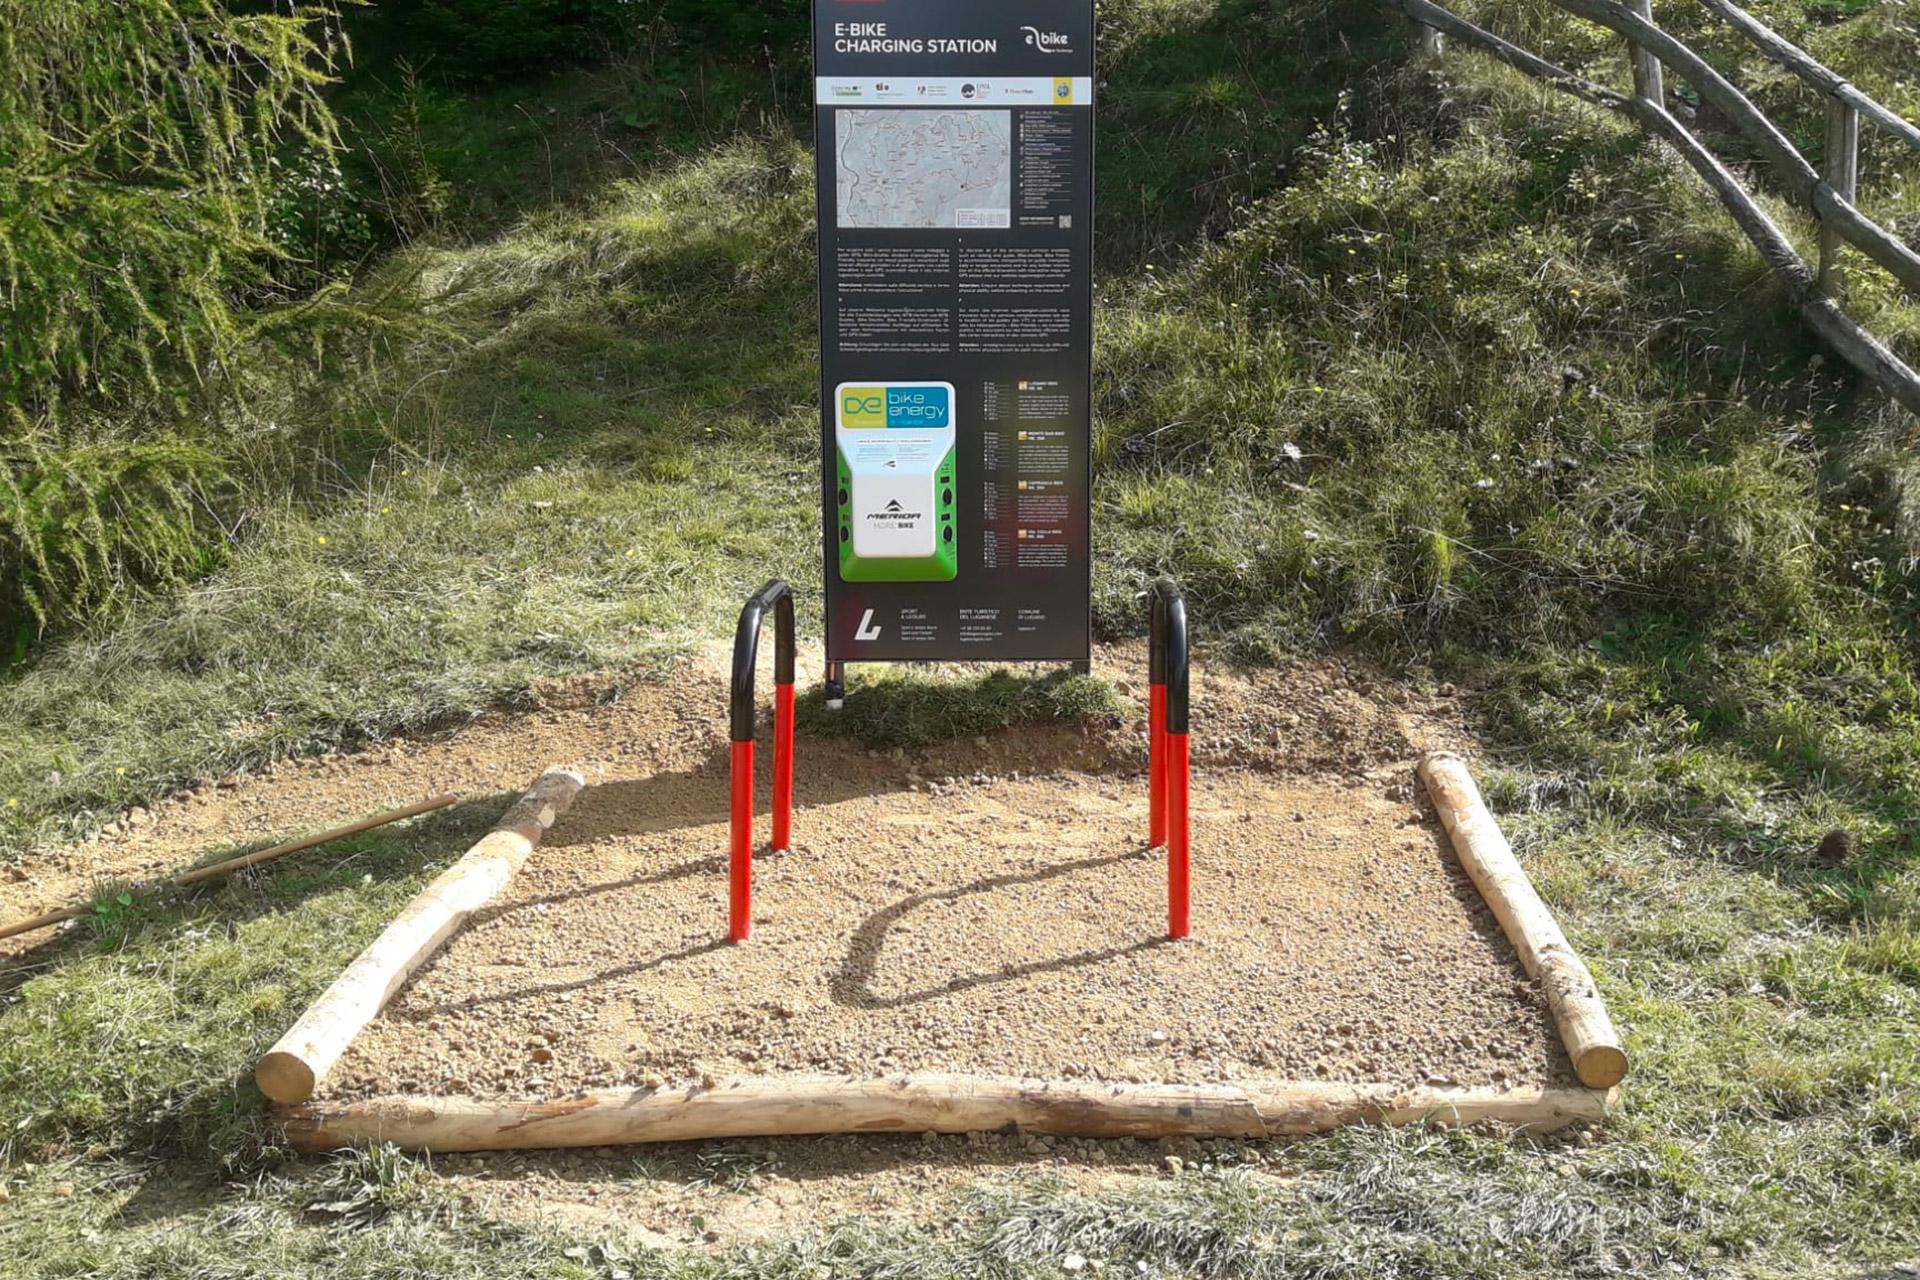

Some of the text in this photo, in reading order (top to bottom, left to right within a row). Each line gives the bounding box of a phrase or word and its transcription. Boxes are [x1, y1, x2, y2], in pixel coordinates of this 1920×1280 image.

[834, 23, 887, 37] E-BIKE
[834, 38, 997, 54] CHARGING STATION
[888, 391, 925, 405] bike
[888, 405, 945, 419] energy
